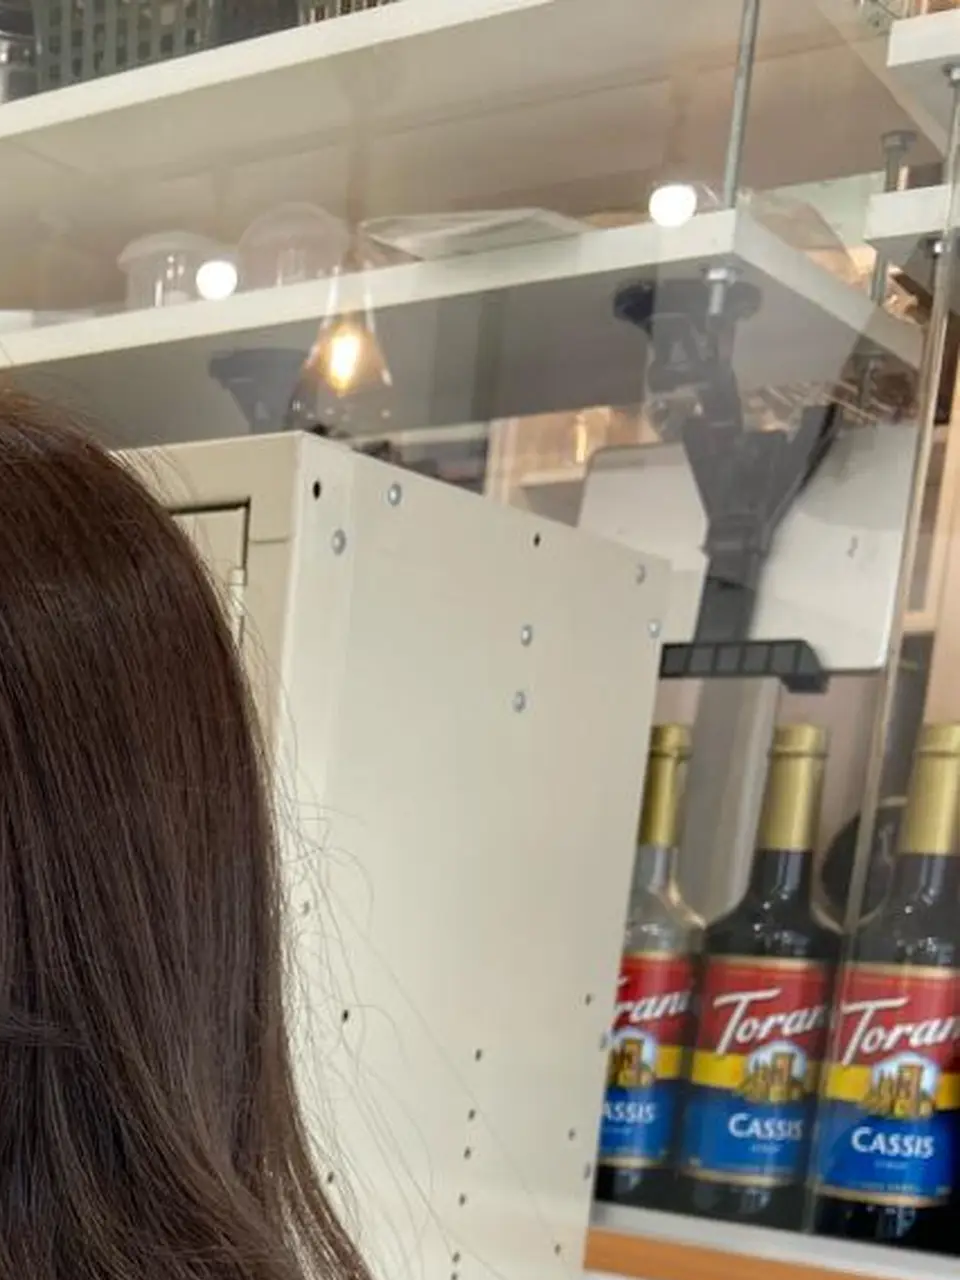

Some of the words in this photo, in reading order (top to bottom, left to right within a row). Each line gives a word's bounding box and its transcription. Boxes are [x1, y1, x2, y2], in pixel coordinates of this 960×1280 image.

[603, 1100, 655, 1125] ASSIS
[728, 1111, 804, 1141] CASSIS
[851, 1125, 935, 1160] CASSIS
